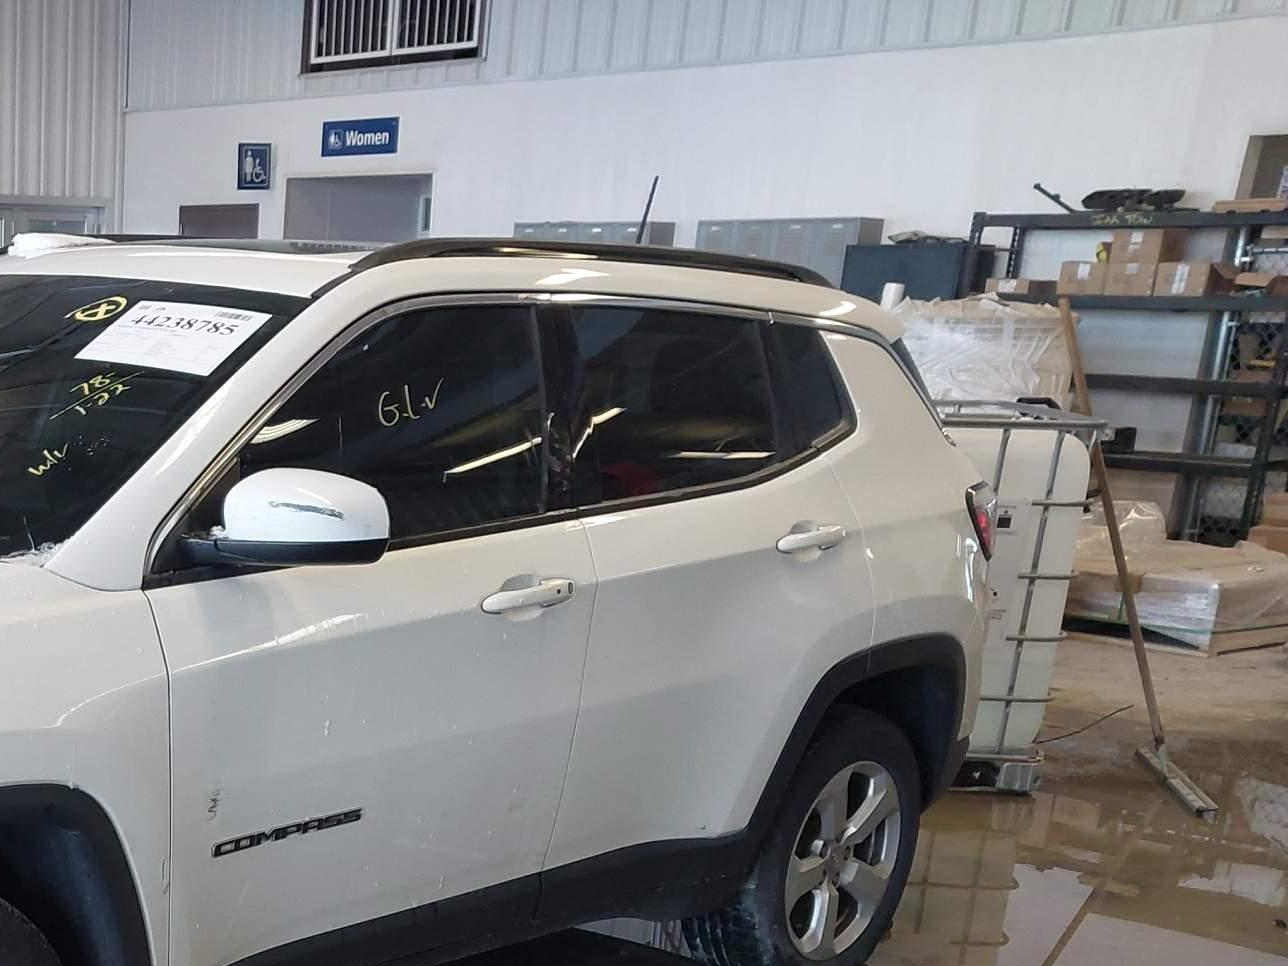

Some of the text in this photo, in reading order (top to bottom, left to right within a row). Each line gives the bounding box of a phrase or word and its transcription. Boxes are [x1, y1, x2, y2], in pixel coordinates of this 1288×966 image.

[345, 129, 390, 147] Women
[130, 313, 241, 337] 44238785
[211, 805, 363, 859] COMPASS
